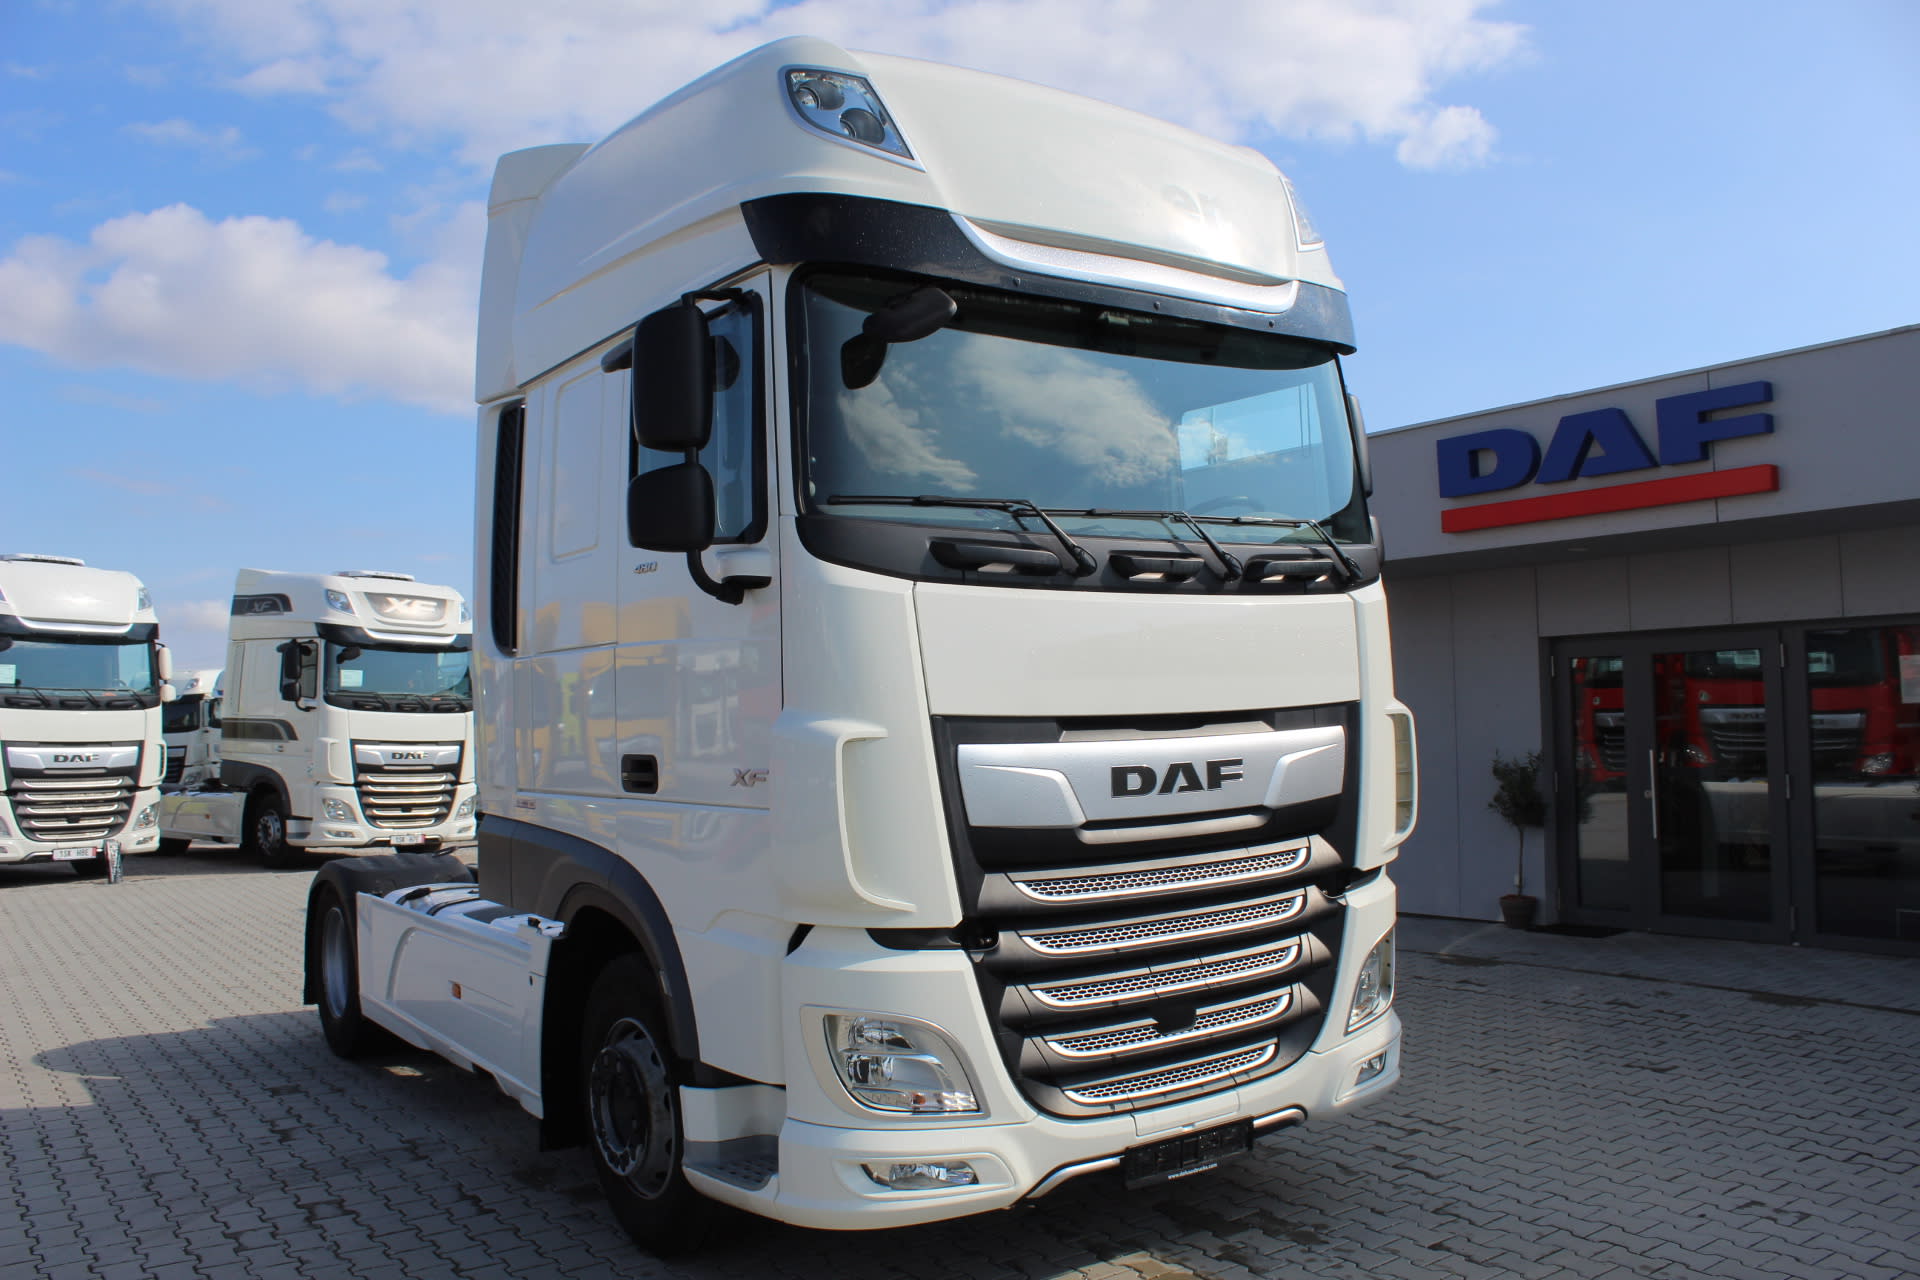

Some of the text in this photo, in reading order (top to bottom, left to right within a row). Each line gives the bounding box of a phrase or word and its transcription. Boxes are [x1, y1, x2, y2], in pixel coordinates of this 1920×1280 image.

[1436, 380, 1774, 498] DAF
[632, 561, 657, 574] 480
[252, 600, 273, 612] XF
[384, 597, 437, 616] XF
[54, 754, 99, 762] DAF
[391, 752, 429, 760] DAF
[729, 767, 769, 787] XF
[1110, 758, 1243, 798] DAF
